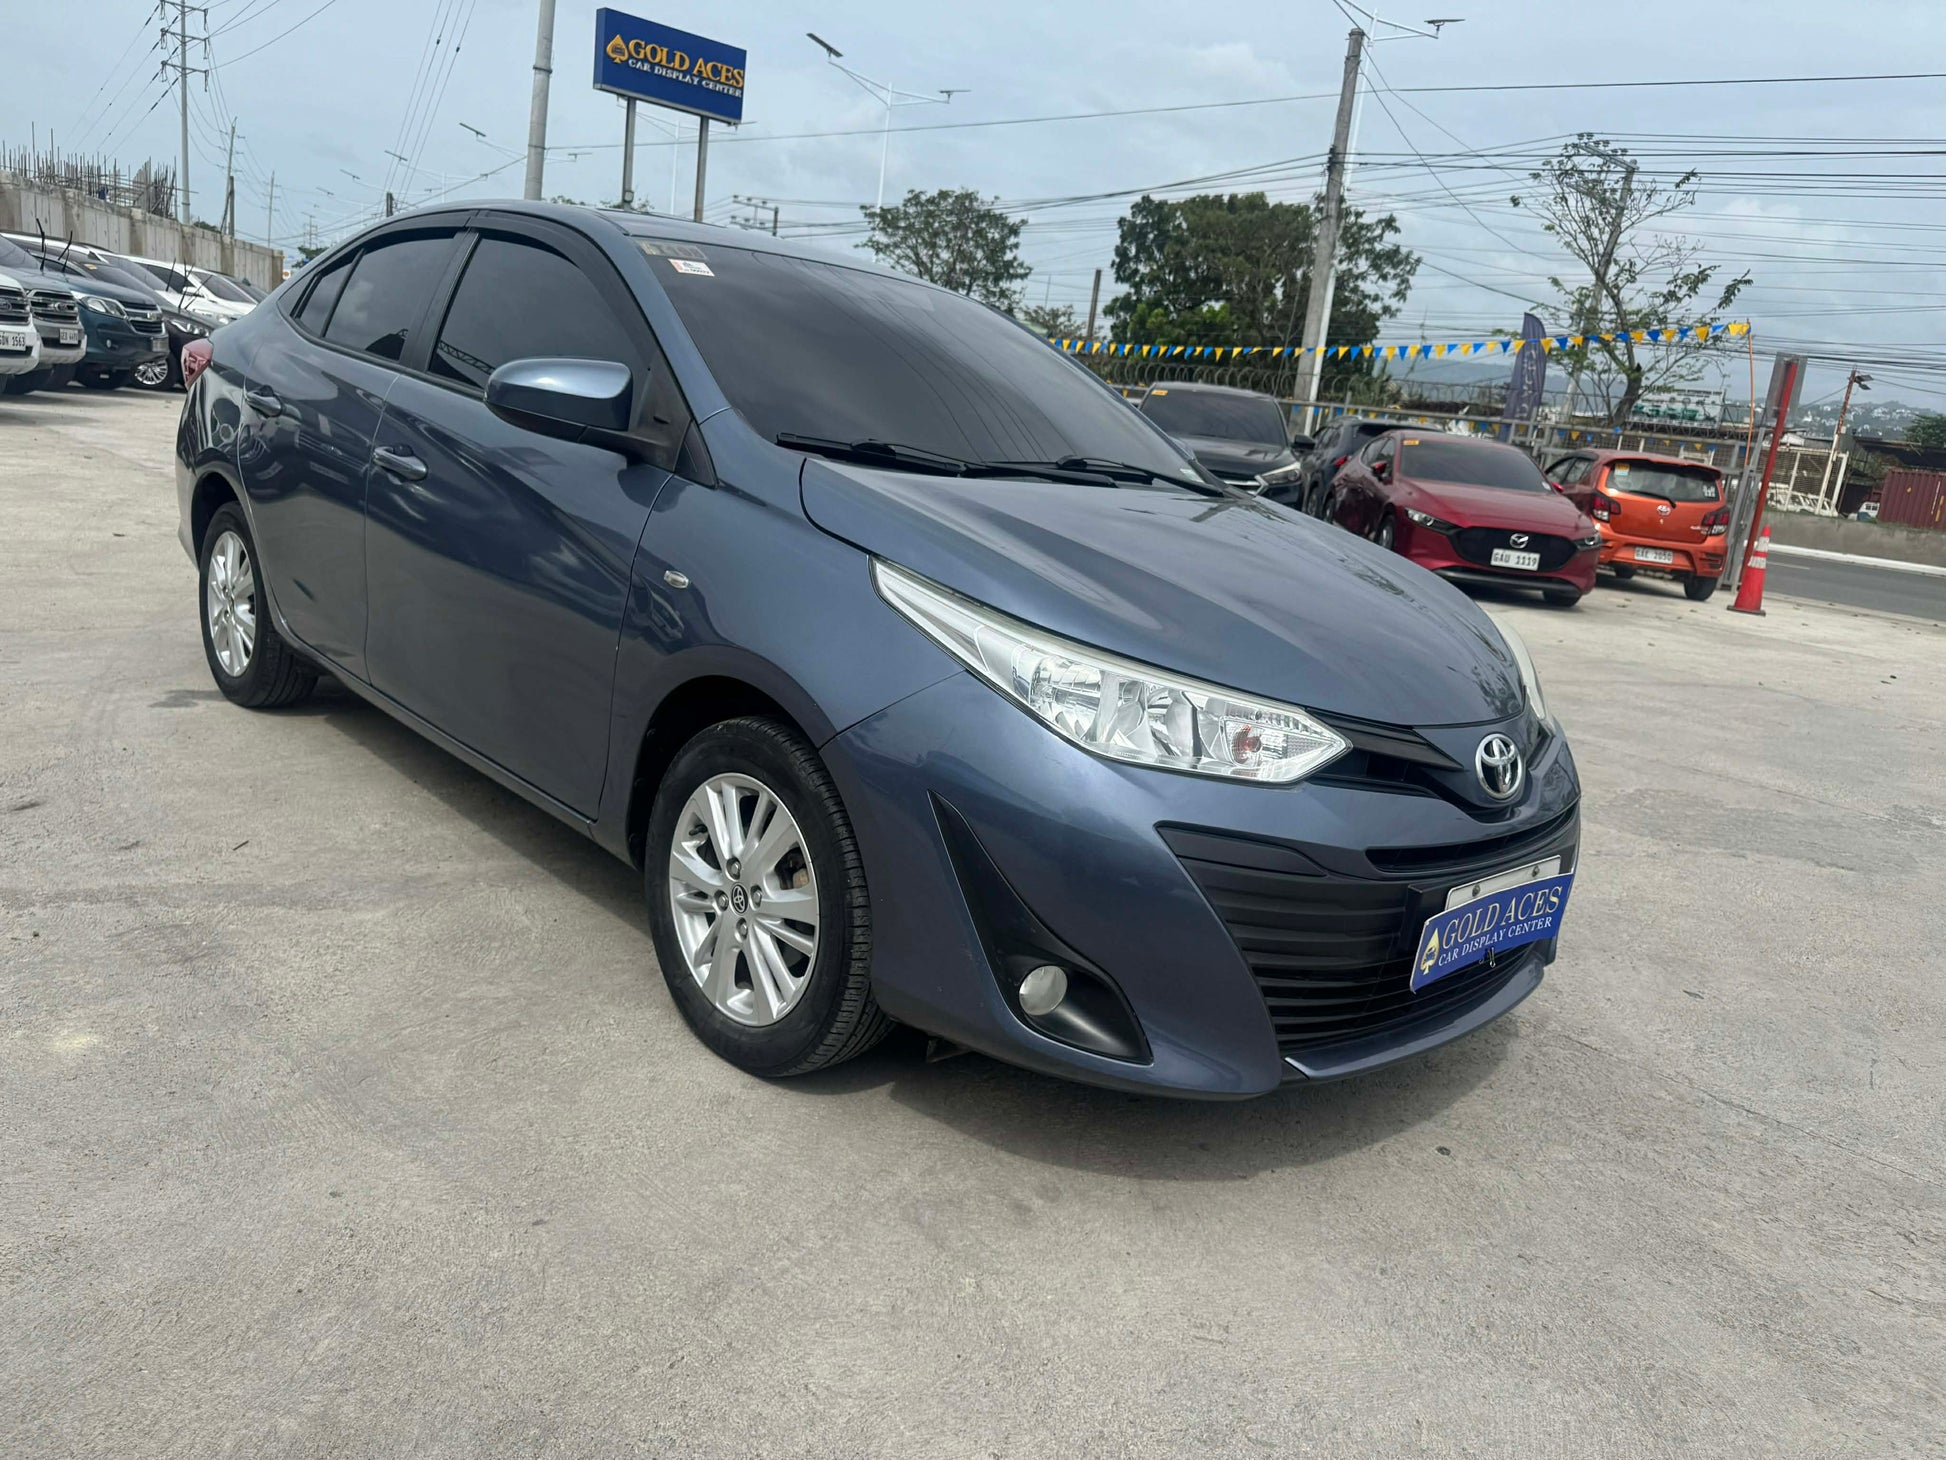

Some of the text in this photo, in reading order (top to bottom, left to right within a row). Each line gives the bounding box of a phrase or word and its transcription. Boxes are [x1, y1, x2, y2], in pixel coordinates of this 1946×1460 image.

[628, 39, 744, 88] GOLD ACES
[628, 58, 742, 98] CAR DISPLAY CENTER
[12, 335, 26, 347] 1563
[1493, 552, 1537, 567] GAU 1119
[1442, 886, 1563, 949] GOLD ACES
[1438, 916, 1553, 967] CAR DISPLAY CENTER
